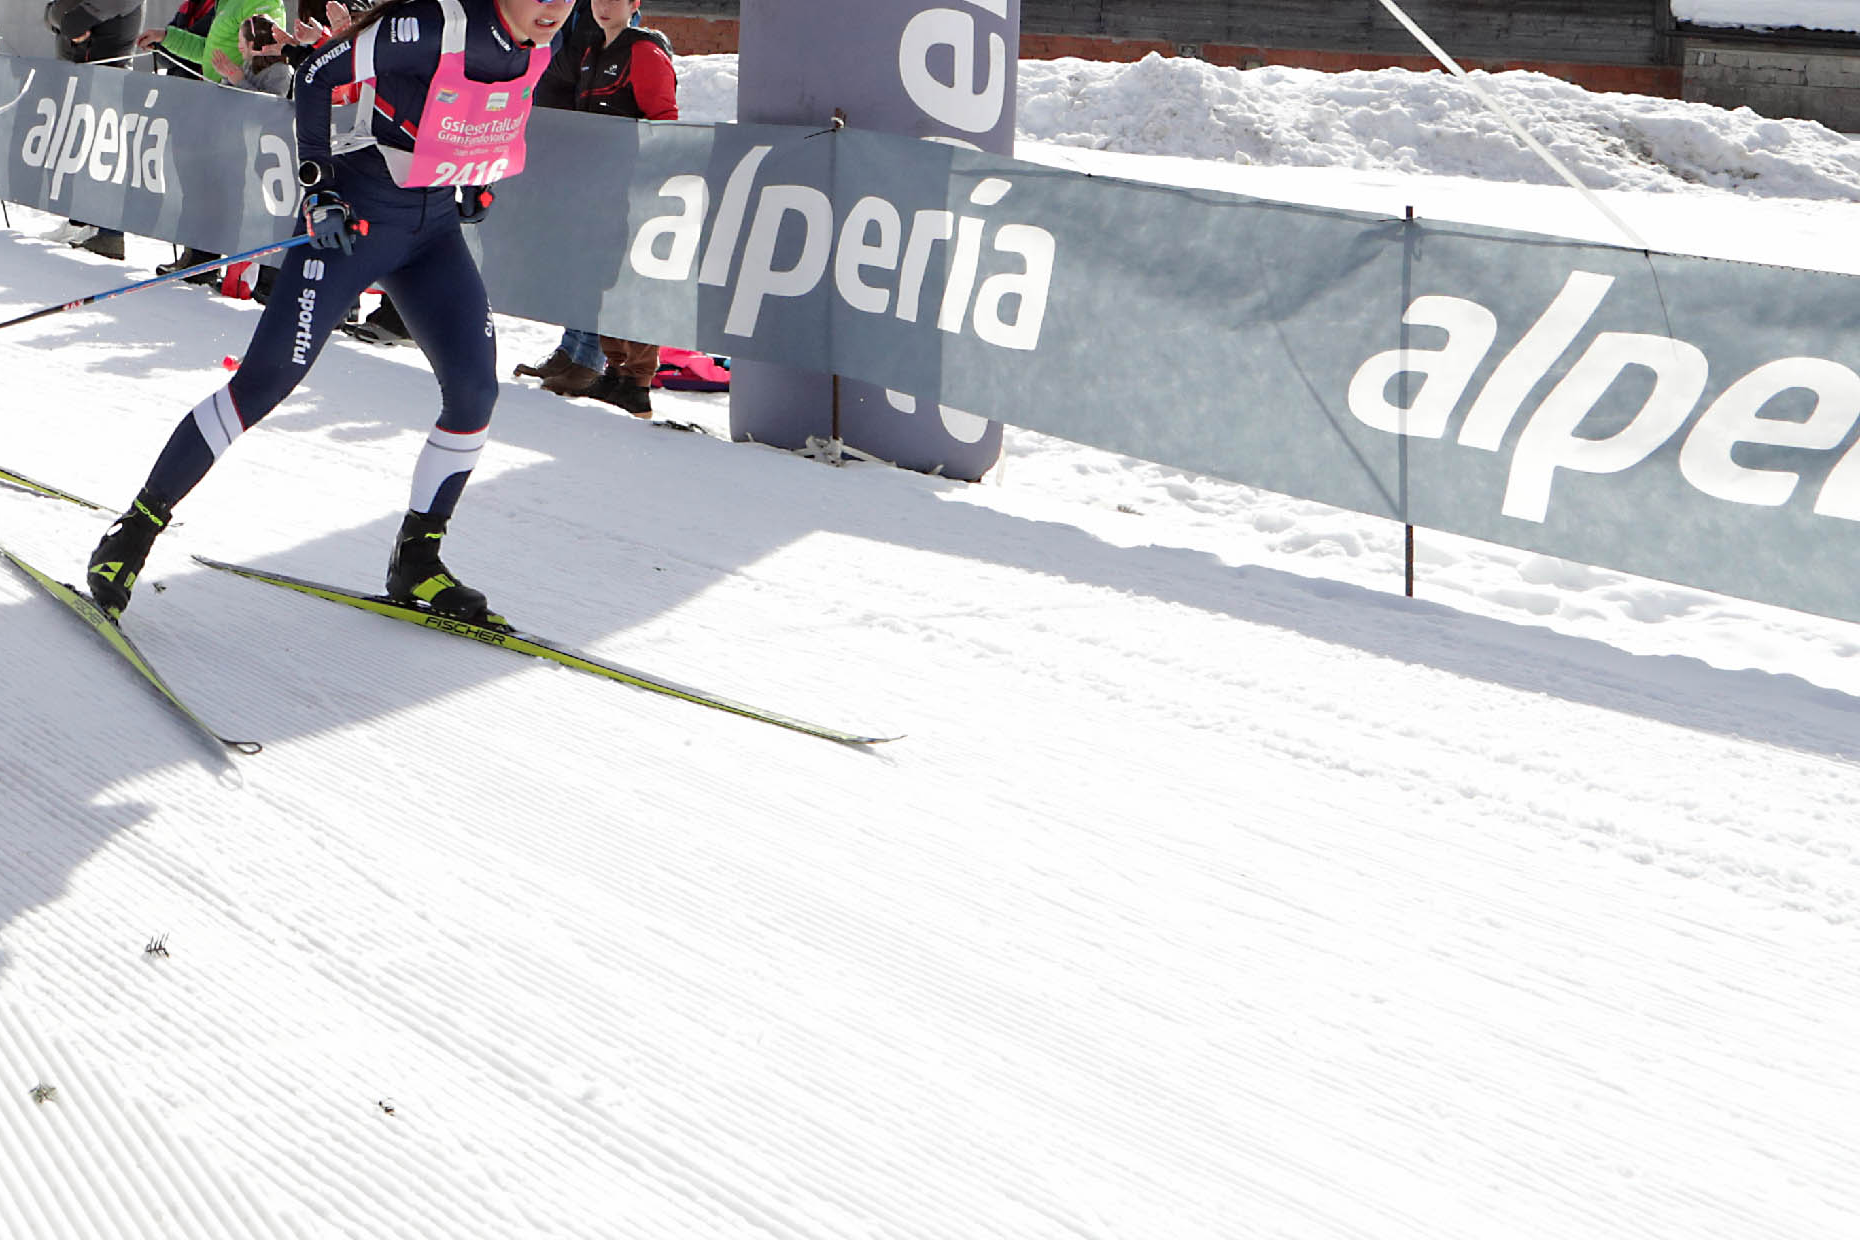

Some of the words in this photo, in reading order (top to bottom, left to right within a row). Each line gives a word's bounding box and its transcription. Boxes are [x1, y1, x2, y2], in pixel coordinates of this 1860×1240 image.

[22, 76, 170, 201] alperia
[428, 158, 509, 187] 2416
[631, 145, 1056, 352] alperia
[291, 288, 316, 366] sportful
[1348, 270, 1860, 524] alpe
[424, 616, 506, 646] FISCHER
